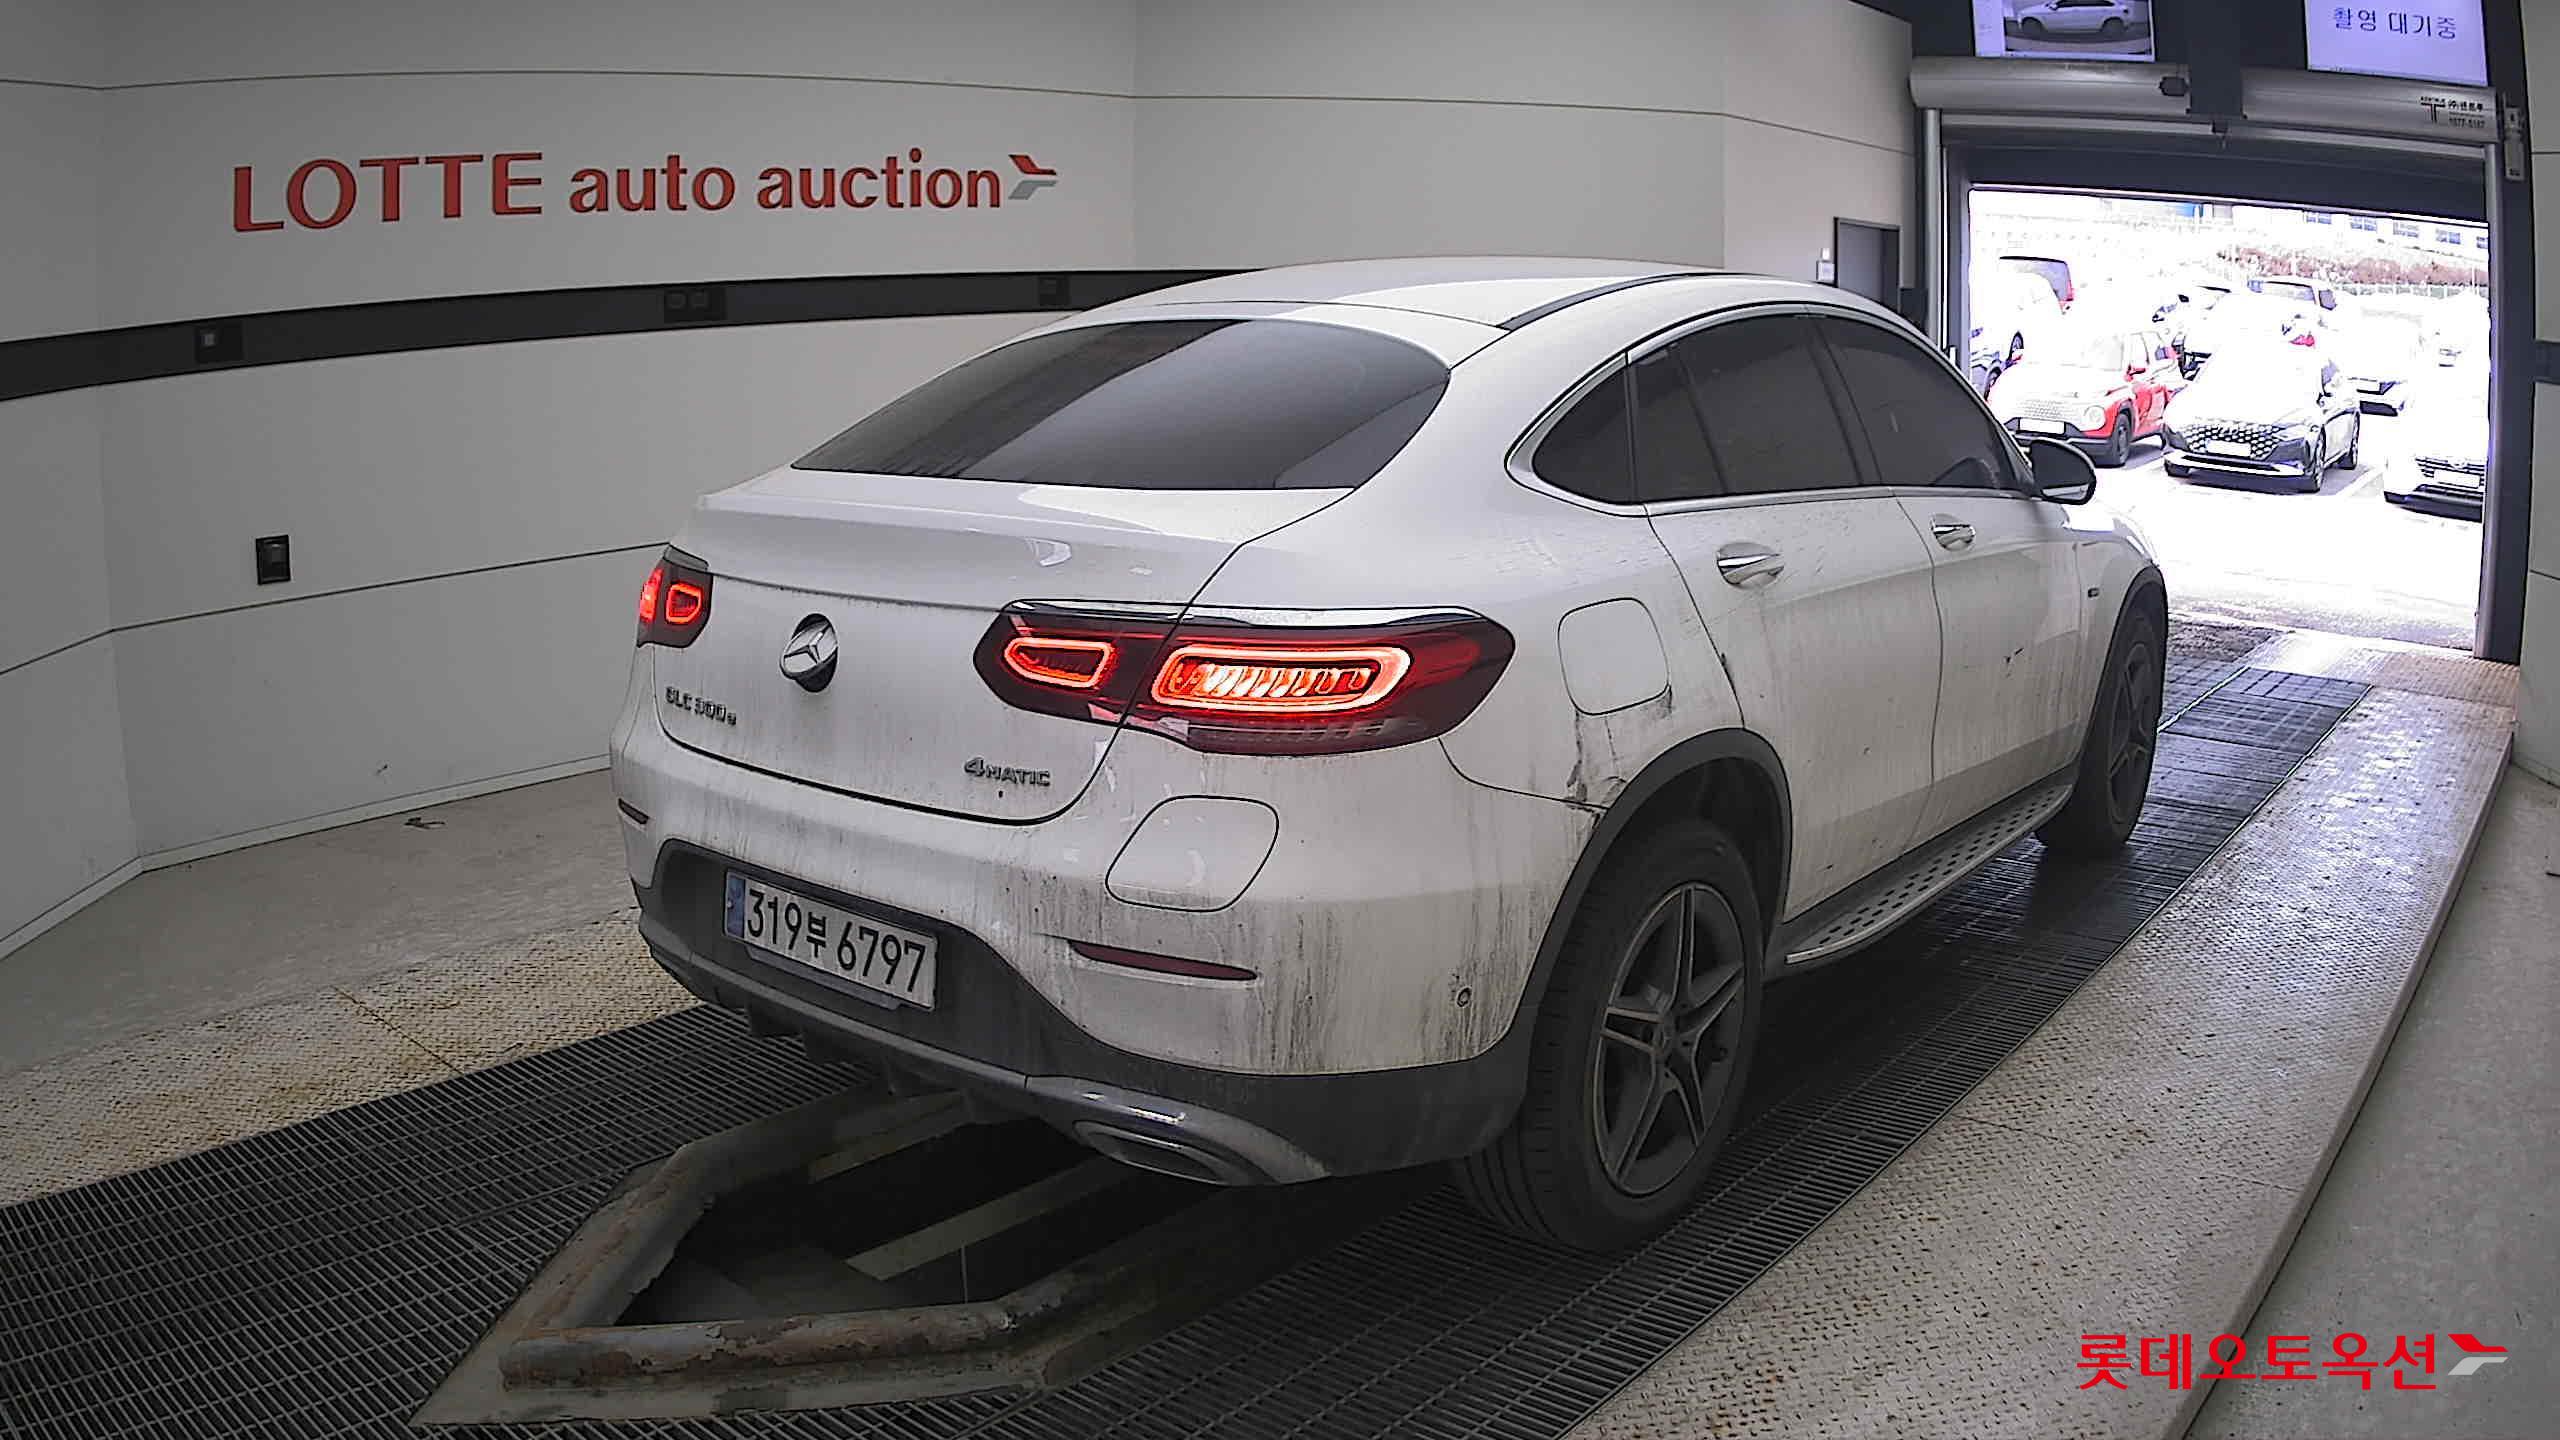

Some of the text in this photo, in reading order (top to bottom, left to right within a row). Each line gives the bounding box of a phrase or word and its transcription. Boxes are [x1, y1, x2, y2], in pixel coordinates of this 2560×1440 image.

[2334, 7, 2457, 40] 촬영 대기중
[232, 147, 1002, 233] LOTTE auto auction
[665, 686, 692, 711] GLC
[964, 757, 1050, 787] 4MATIC
[747, 888, 926, 993] 319부 6797
